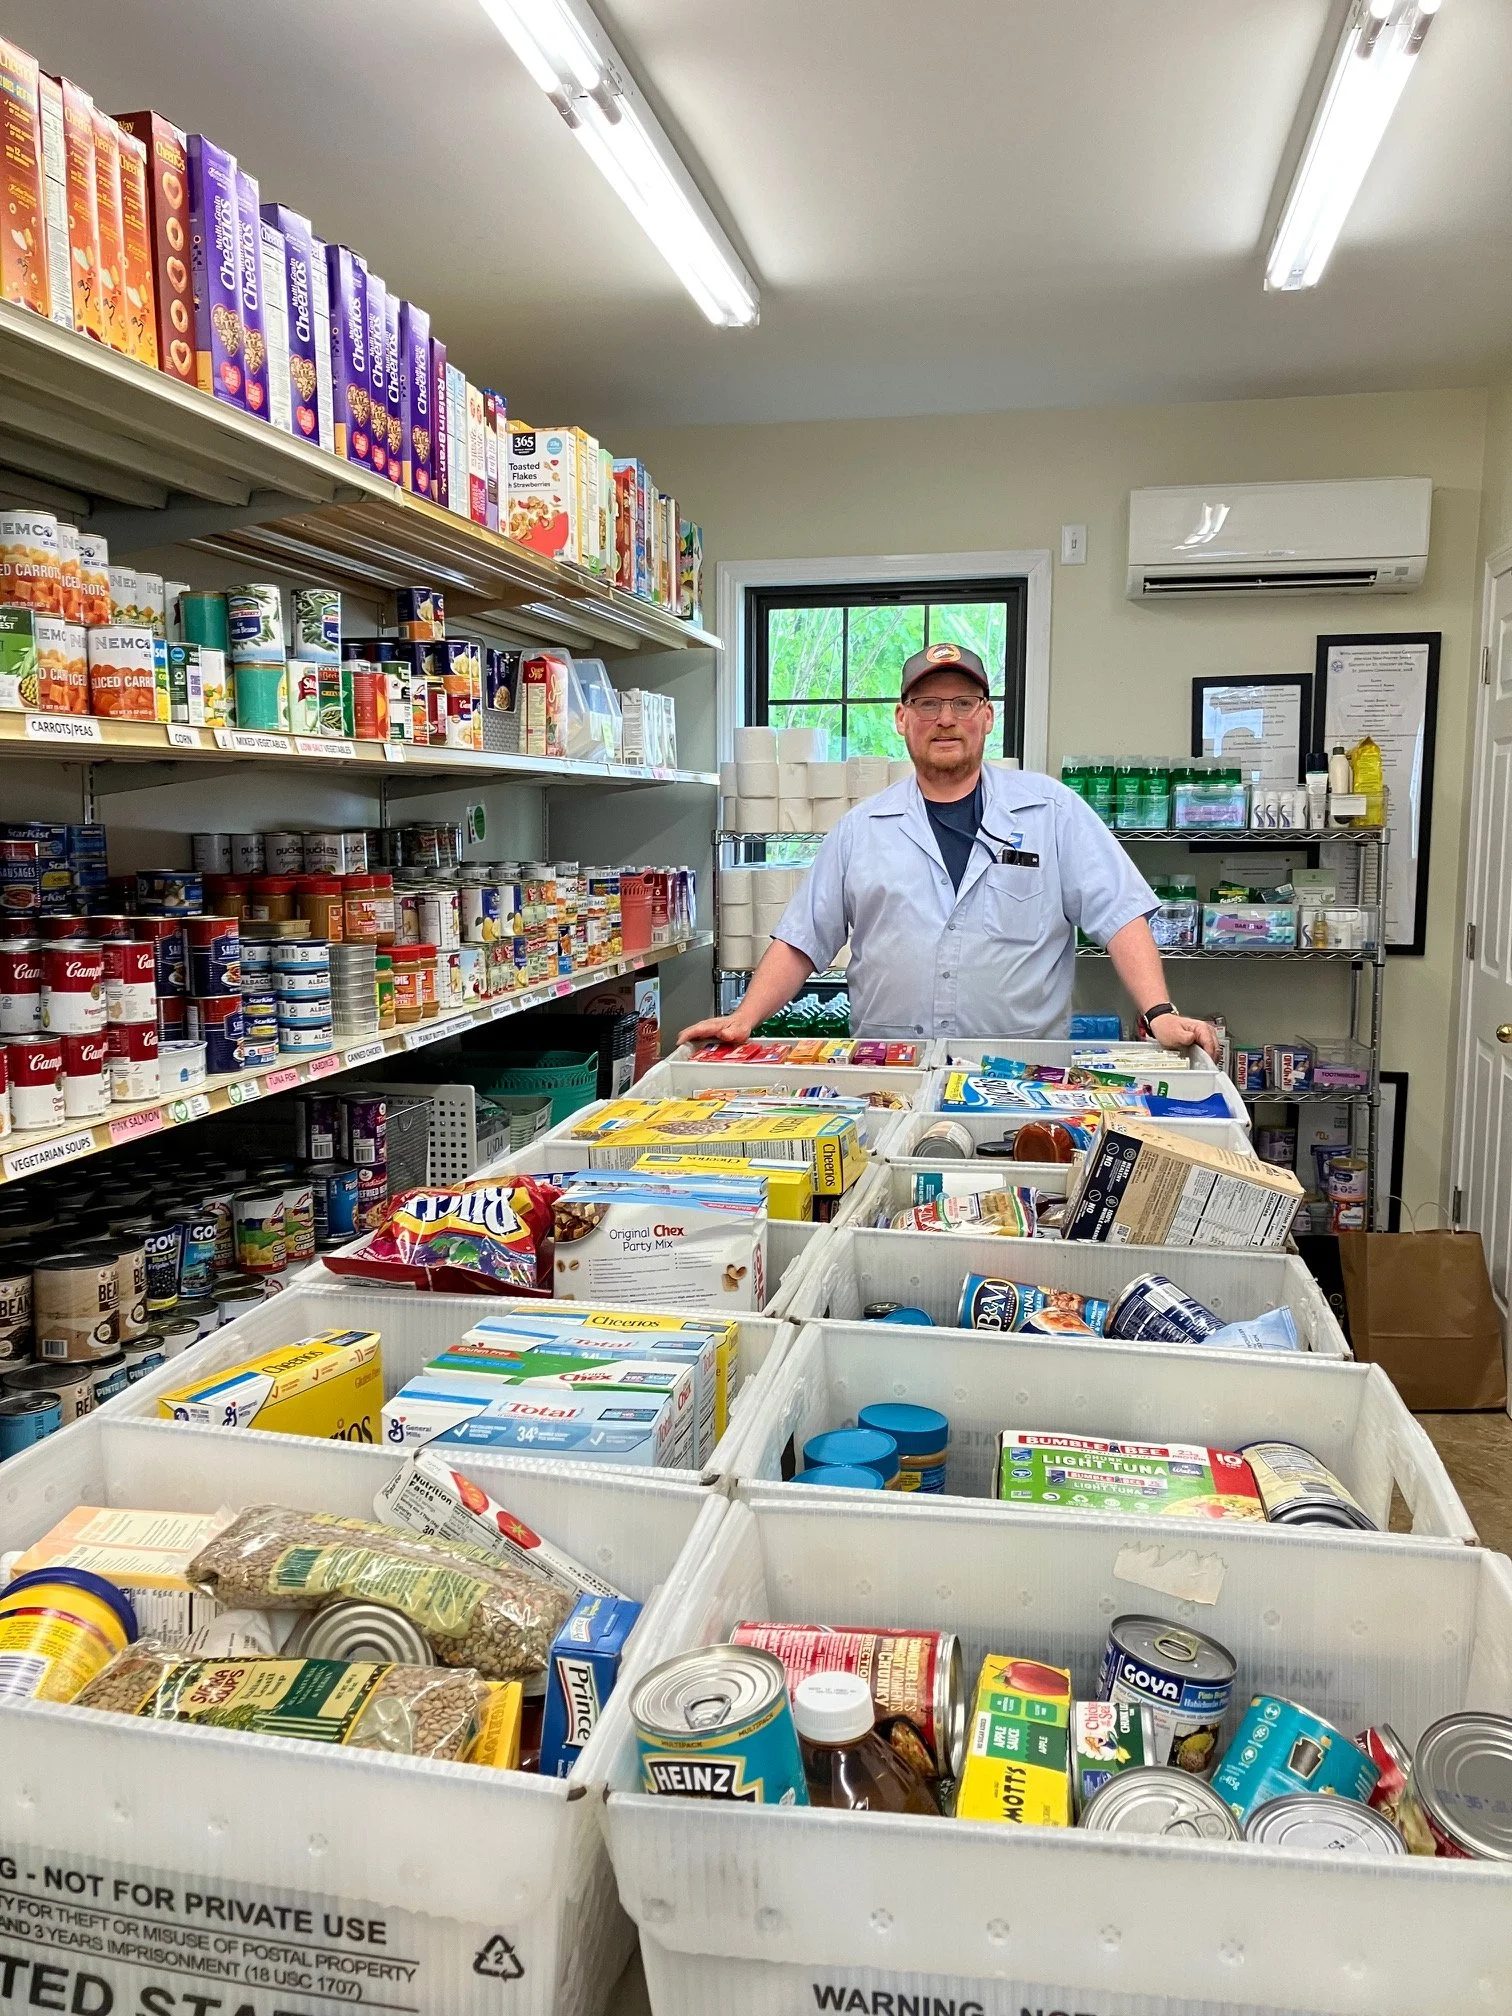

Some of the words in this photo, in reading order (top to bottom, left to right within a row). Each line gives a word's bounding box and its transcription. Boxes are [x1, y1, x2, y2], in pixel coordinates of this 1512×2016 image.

[220, 198, 236, 290] Cheerios
[242, 222, 258, 311] Cheerios
[296, 260, 308, 342] Cheerios
[351, 296, 365, 372] Cheerios
[372, 314, 384, 387] Cheerios
[388, 332, 399, 404] Cheerios
[417, 345, 427, 415] Cheerios
[437, 376, 446, 427] Raisin
[437, 427, 447, 471] Bran
[514, 435, 534, 449] 365
[508, 462, 540, 470] Toasted
[512, 472, 537, 481] Flakes
[513, 482, 551, 490] Strawberries
[91, 675, 121, 689] SLICED
[31, 720, 94, 738] CARROTS/PEAS
[174, 733, 193, 745] CORN
[235, 736, 255, 747] MIXED
[255, 738, 288, 749] VEGETABLES
[324, 744, 352, 755] VEGETABLES
[8, 828, 50, 839] StarKist
[347, 1050, 366, 1062] CANNED
[366, 1045, 382, 1056] CHICKEN
[312, 1058, 334, 1072] SARDINES
[1237, 1054, 1247, 1086] BAND-AID
[268, 1076, 284, 1086] TUNA
[284, 1072, 297, 1081] FISH
[110, 1120, 128, 1133] PINK
[128, 1111, 160, 1130] SALMON
[10, 1143, 64, 1173] VEGETARIAN
[67, 1137, 91, 1155] SOUPS
[822, 1143, 836, 1187] Cheerios
[1104, 1155, 1114, 1167] NO
[1087, 1203, 1097, 1213] NO
[1263, 1192, 1277, 1217] Calories
[1282, 1198, 1298, 1224] Nutrition
[609, 1226, 651, 1241] Original
[653, 1224, 685, 1237] Chex
[1276, 1225, 1288, 1241] Facts
[145, 1233, 175, 1253] GOY
[623, 1240, 651, 1253] Party
[655, 1239, 673, 1250] Mix
[592, 1316, 661, 1328] Cheerios
[457, 1346, 489, 1355] Gluten
[490, 1349, 512, 1357] Free
[573, 1338, 631, 1349] Total
[262, 1349, 324, 1375] Cheerios
[559, 1373, 613, 1382] Chex
[509, 1402, 577, 1418] Total
[405, 1424, 431, 1433] General
[405, 1431, 421, 1439] Mills
[1025, 1436, 1108, 1452] BUMBLE
[1127, 1445, 1164, 1456] BEE
[1041, 1454, 1110, 1470] LIGHT
[1111, 1462, 1167, 1477] TUNA
[1083, 1453, 1121, 1463] CHUNK
[1172, 1454, 1207, 1462] PROTEIN
[1215, 1453, 1243, 1466] 10
[1070, 1471, 1113, 1482] BUMBLE
[1125, 1477, 1144, 1486] BEE
[1171, 1466, 1202, 1476] Water
[408, 1480, 435, 1503] Facts
[412, 1473, 453, 1507] Nutrition
[1073, 1482, 1110, 1493] LIGHT
[1112, 1485, 1142, 1496] TUNA
[422, 1524, 436, 1537] 30
[860, 1634, 876, 1679] DIRECTIO
[909, 1638, 922, 1675] CONQUER
[875, 1652, 894, 1707] CHUNKY
[890, 1667, 905, 1711] MOMENTS
[1124, 1663, 1180, 1701] GOYA
[568, 1665, 593, 1741] Prince
[905, 1675, 919, 1712] LIFE'S
[737, 1712, 775, 1737] MULTIPACK
[1099, 1705, 1113, 1724] Sea
[1120, 1712, 1130, 1733] CHUNK
[661, 1740, 703, 1749] MULTIPACK
[993, 1725, 1007, 1749] APPLE
[1007, 1728, 1020, 1751] SAUCE
[1038, 1735, 1048, 1755] APPLE
[656, 1764, 731, 1793] HEINZ
[1001, 1765, 1027, 1824] MOTT'S
[43, 1864, 104, 1900] NOT
[113, 1880, 175, 1913] FOR
[184, 1890, 314, 1935] PRIVATE
[322, 1914, 388, 1945] USE
[17, 1899, 55, 1922] FOR
[55, 1902, 112, 1934] THEFT
[113, 1917, 140, 1938] OR
[141, 1921, 211, 1950] MISUSE
[212, 1933, 240, 1955] OF
[241, 1939, 313, 1968] POSTAL
[314, 1953, 417, 1984] PROPERTY
[34, 1921, 44, 1938] 3
[45, 1924, 104, 1953] YEARS
[106, 1936, 242, 1979] IMPRISONMENT
[243, 1963, 271, 1985] (18
[272, 1967, 311, 1990] USC
[317, 1974, 363, 2001] 1707)
[811, 1982, 986, 2016] WARNING
